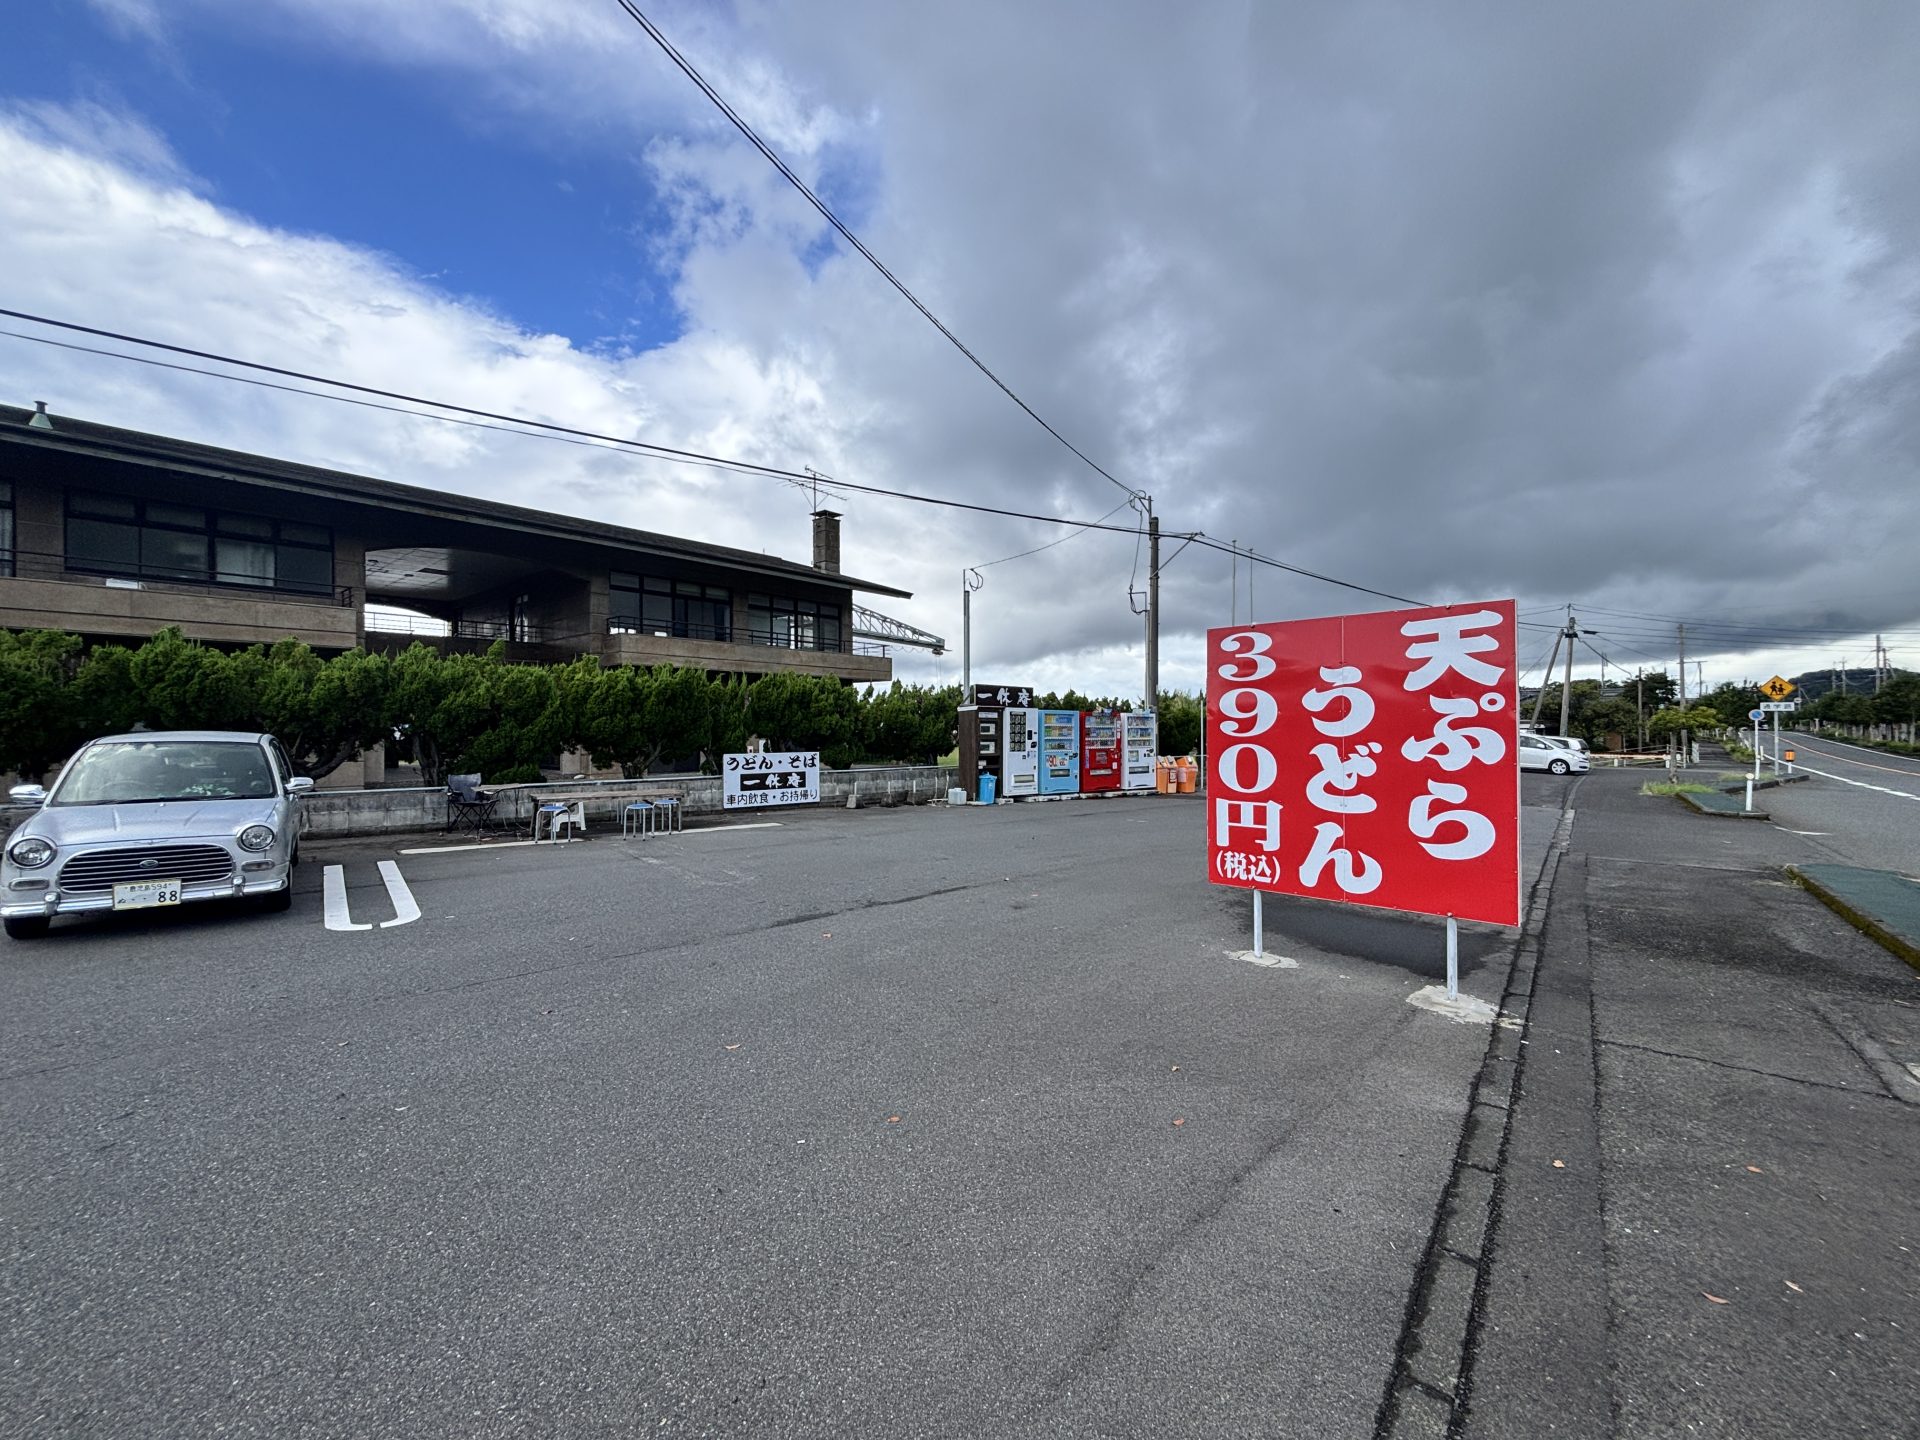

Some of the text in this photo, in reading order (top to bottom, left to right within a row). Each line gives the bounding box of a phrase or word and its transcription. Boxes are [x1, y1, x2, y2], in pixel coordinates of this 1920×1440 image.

[742, 772, 803, 789] 一休庵
[977, 687, 1032, 708] 一休庵
[1215, 631, 1284, 852] 390円
[1299, 665, 1383, 895] うどん
[1400, 609, 1507, 861] 天ぷら
